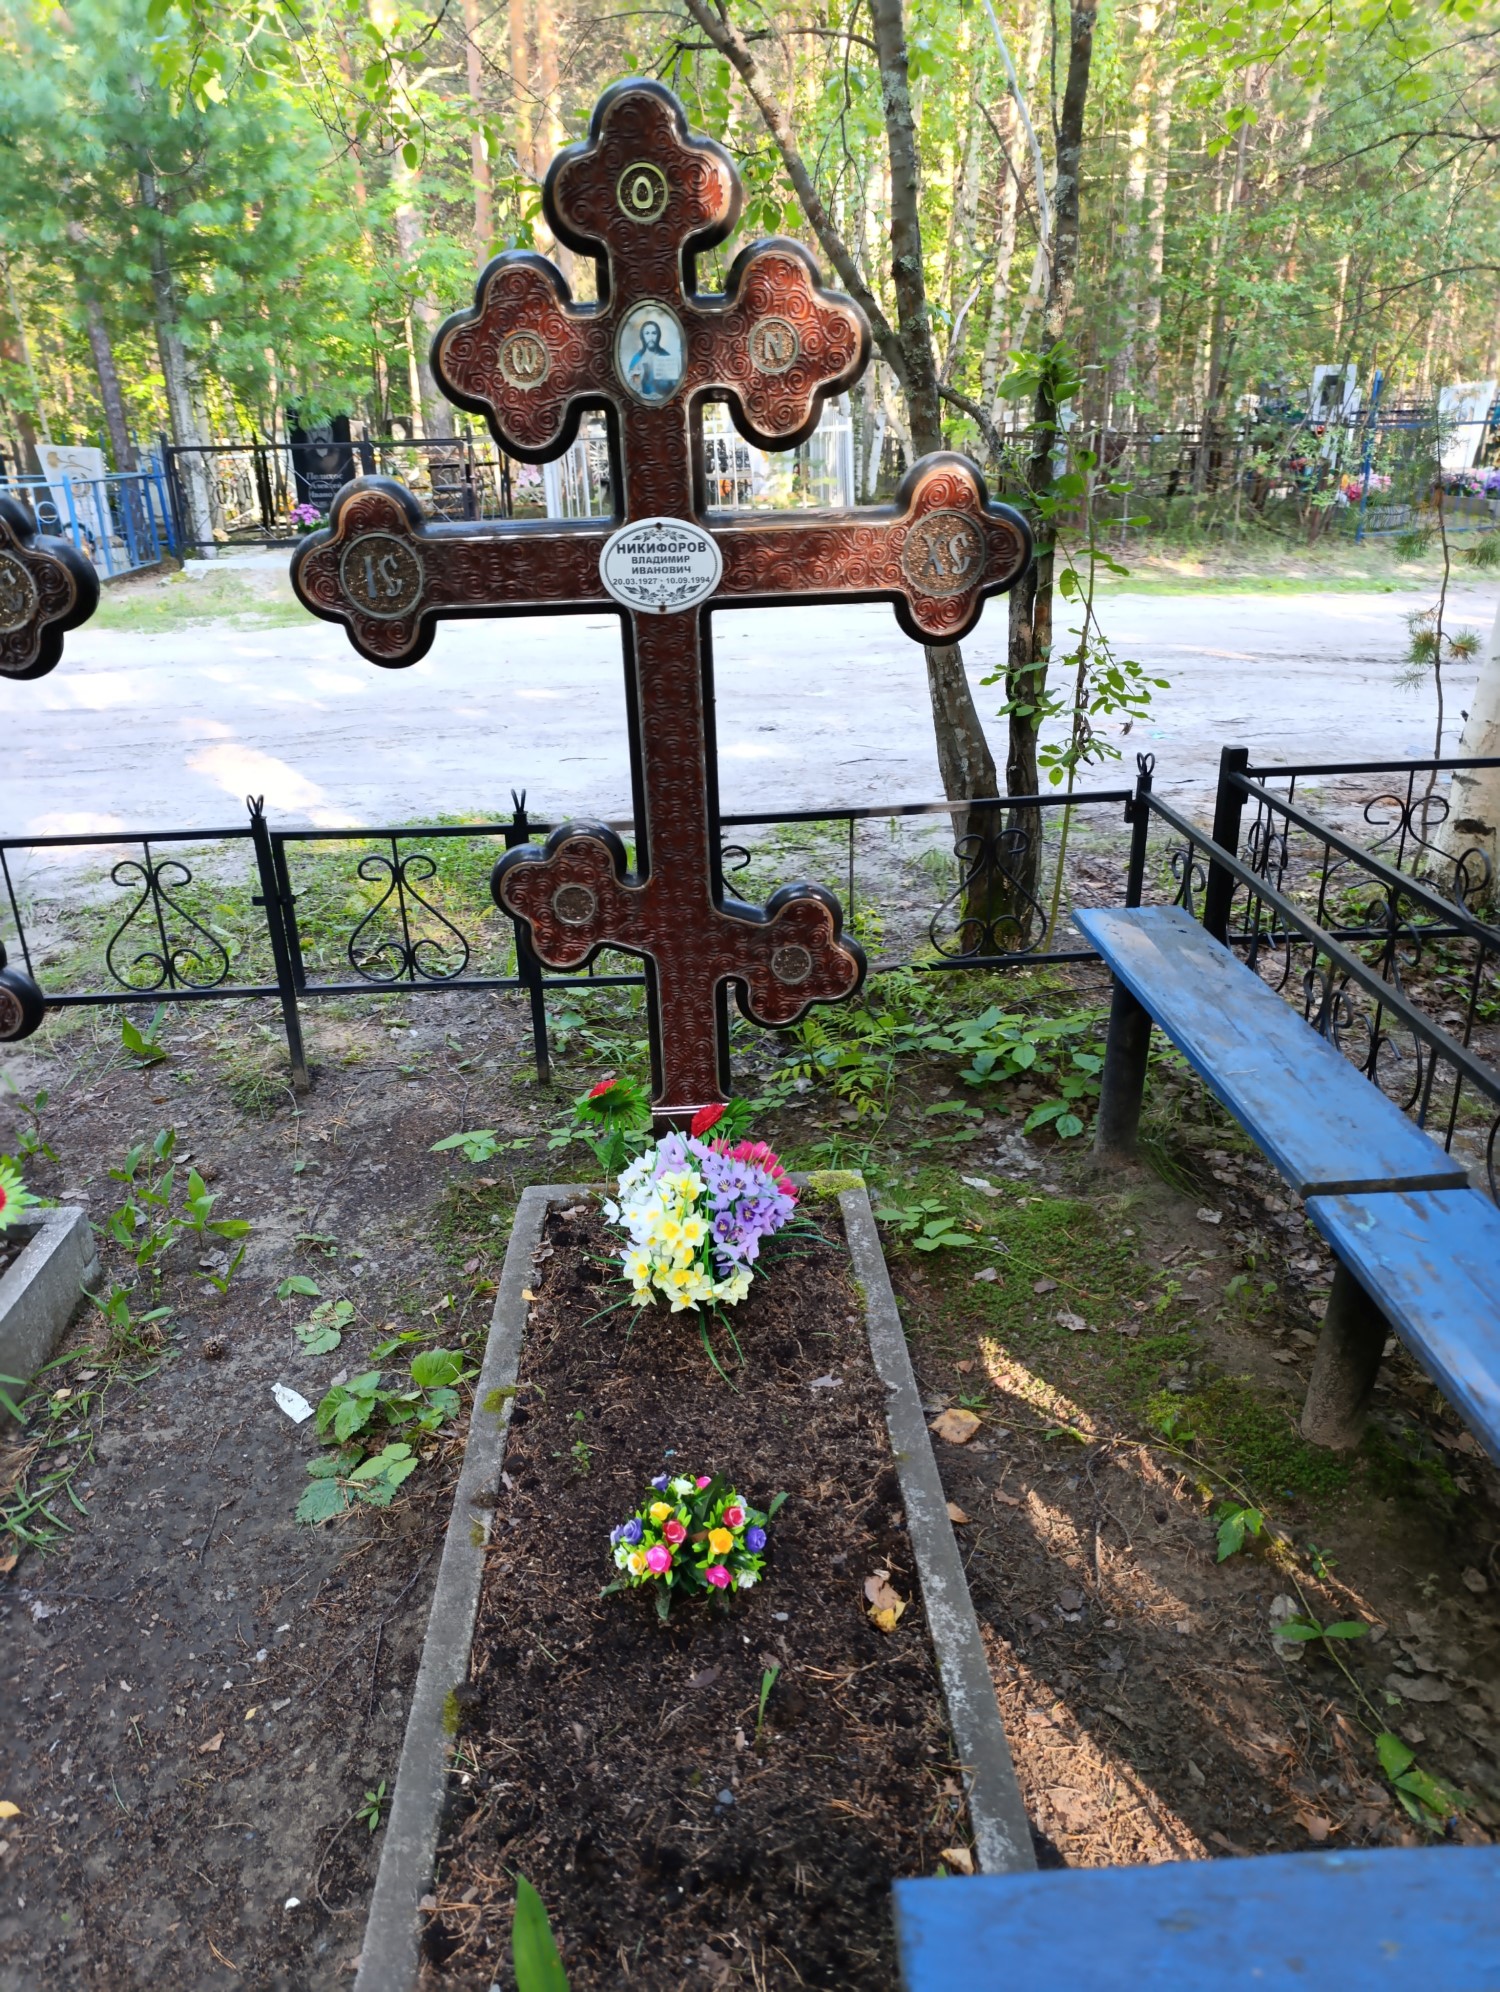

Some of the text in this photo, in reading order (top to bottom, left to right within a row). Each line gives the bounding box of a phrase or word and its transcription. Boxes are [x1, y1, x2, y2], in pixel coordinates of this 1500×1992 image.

[617, 542, 707, 554] НИКИФОРОВ
[631, 555, 690, 565] ВЛАДИМИР
[631, 566, 691, 574] ИВАНОВИЧ
[666, 576, 710, 584] 10.09.1994
